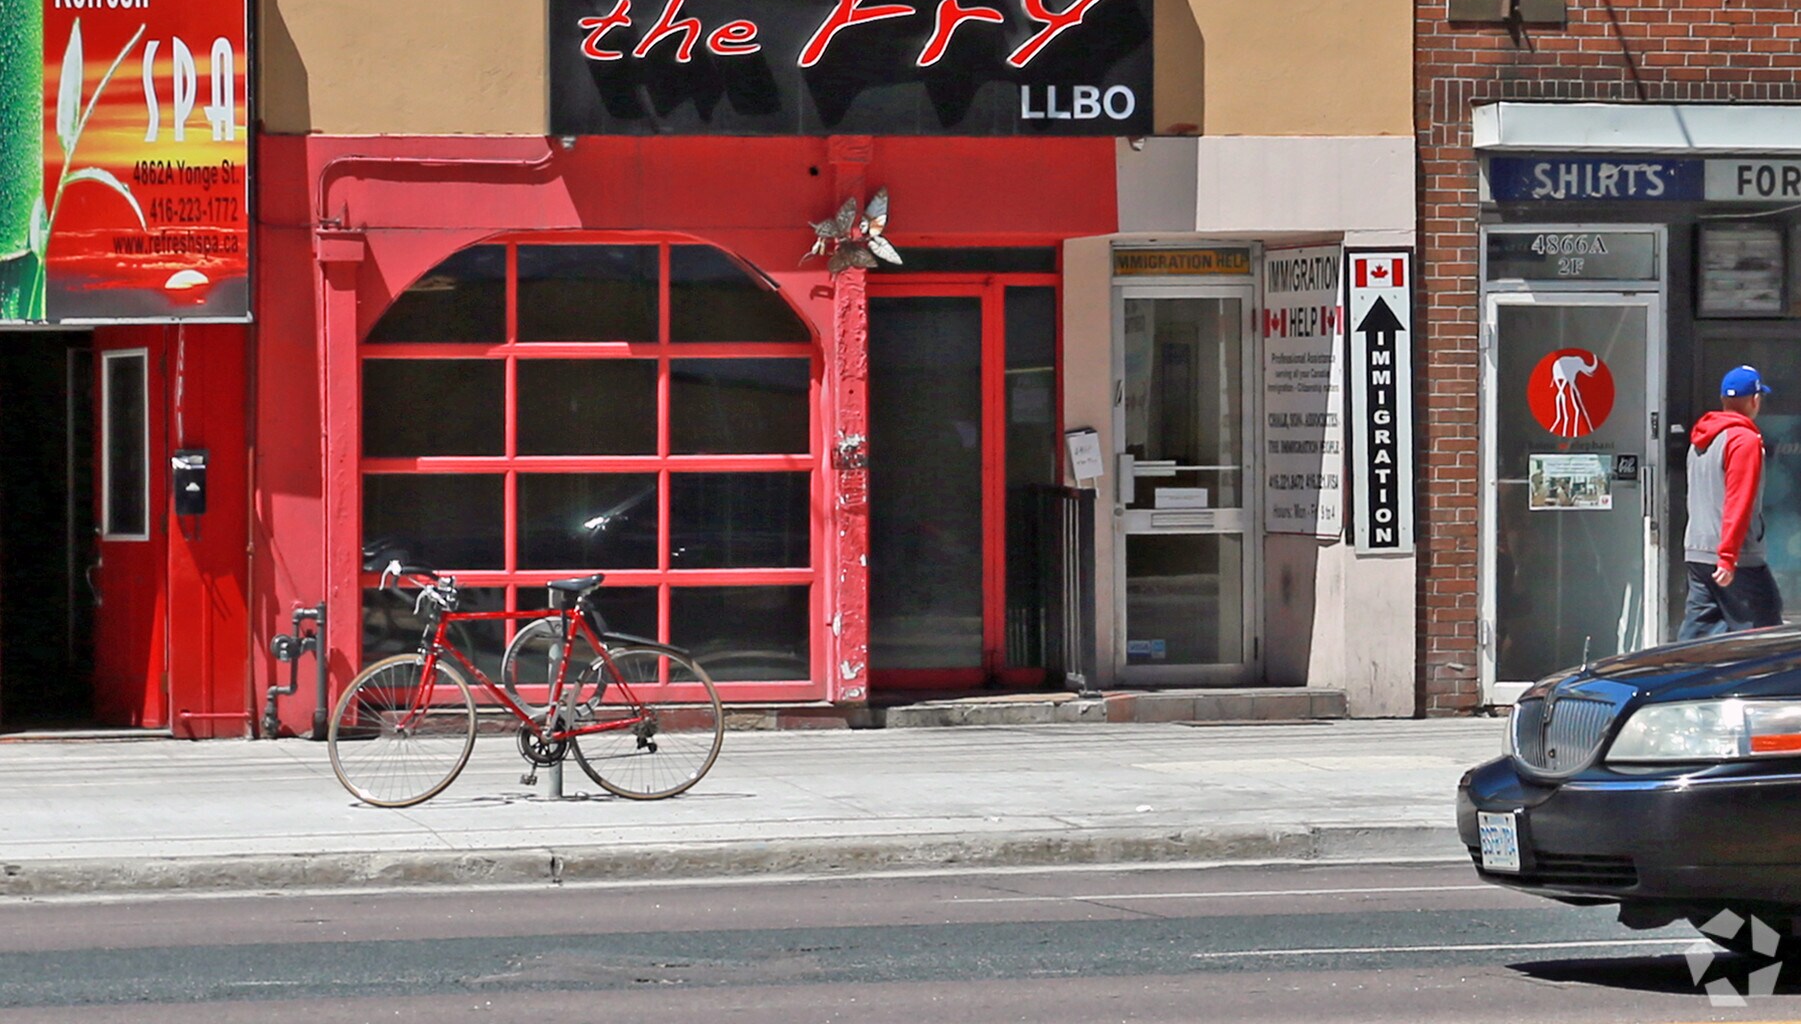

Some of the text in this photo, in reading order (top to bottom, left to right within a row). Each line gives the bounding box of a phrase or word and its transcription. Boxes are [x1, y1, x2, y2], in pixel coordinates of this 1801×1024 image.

[142, 36, 236, 143] SPA
[1020, 84, 1136, 120] LLBO
[133, 159, 240, 191] 4862A Yonge St.
[1532, 162, 1666, 199] SHIRTS
[1736, 164, 1801, 197] FOR
[150, 197, 238, 223] 416-223-1772
[113, 229, 239, 260] www.refreshspa.ca
[1531, 234, 1609, 255] 4866A
[1268, 256, 1341, 293] IMMIGRATION
[1558, 258, 1585, 276] 2F
[1289, 307, 1318, 337] HELP
[1371, 331, 1393, 543] IMMIGRATION
